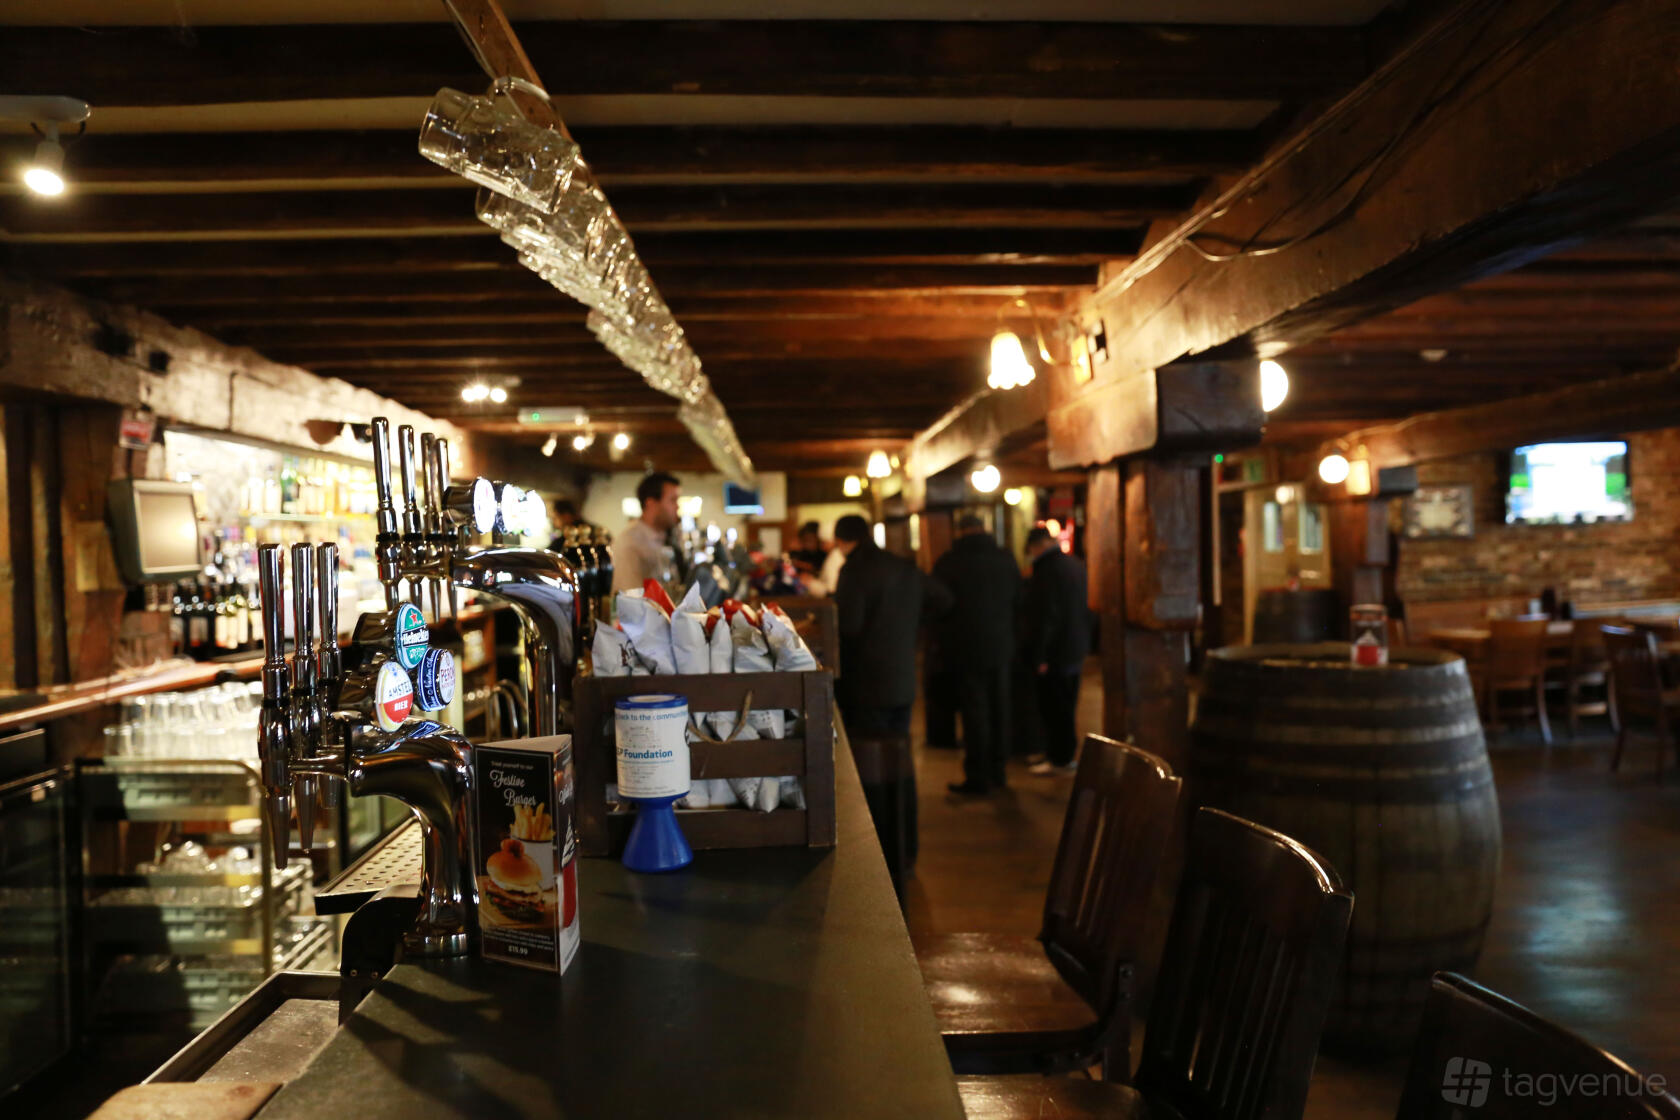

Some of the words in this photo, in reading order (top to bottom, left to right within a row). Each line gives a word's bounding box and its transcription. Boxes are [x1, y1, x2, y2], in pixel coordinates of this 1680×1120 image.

[640, 713, 651, 721] the
[624, 749, 673, 759] Foundation
[489, 769, 526, 788] Festive
[503, 788, 537, 808] Burger
